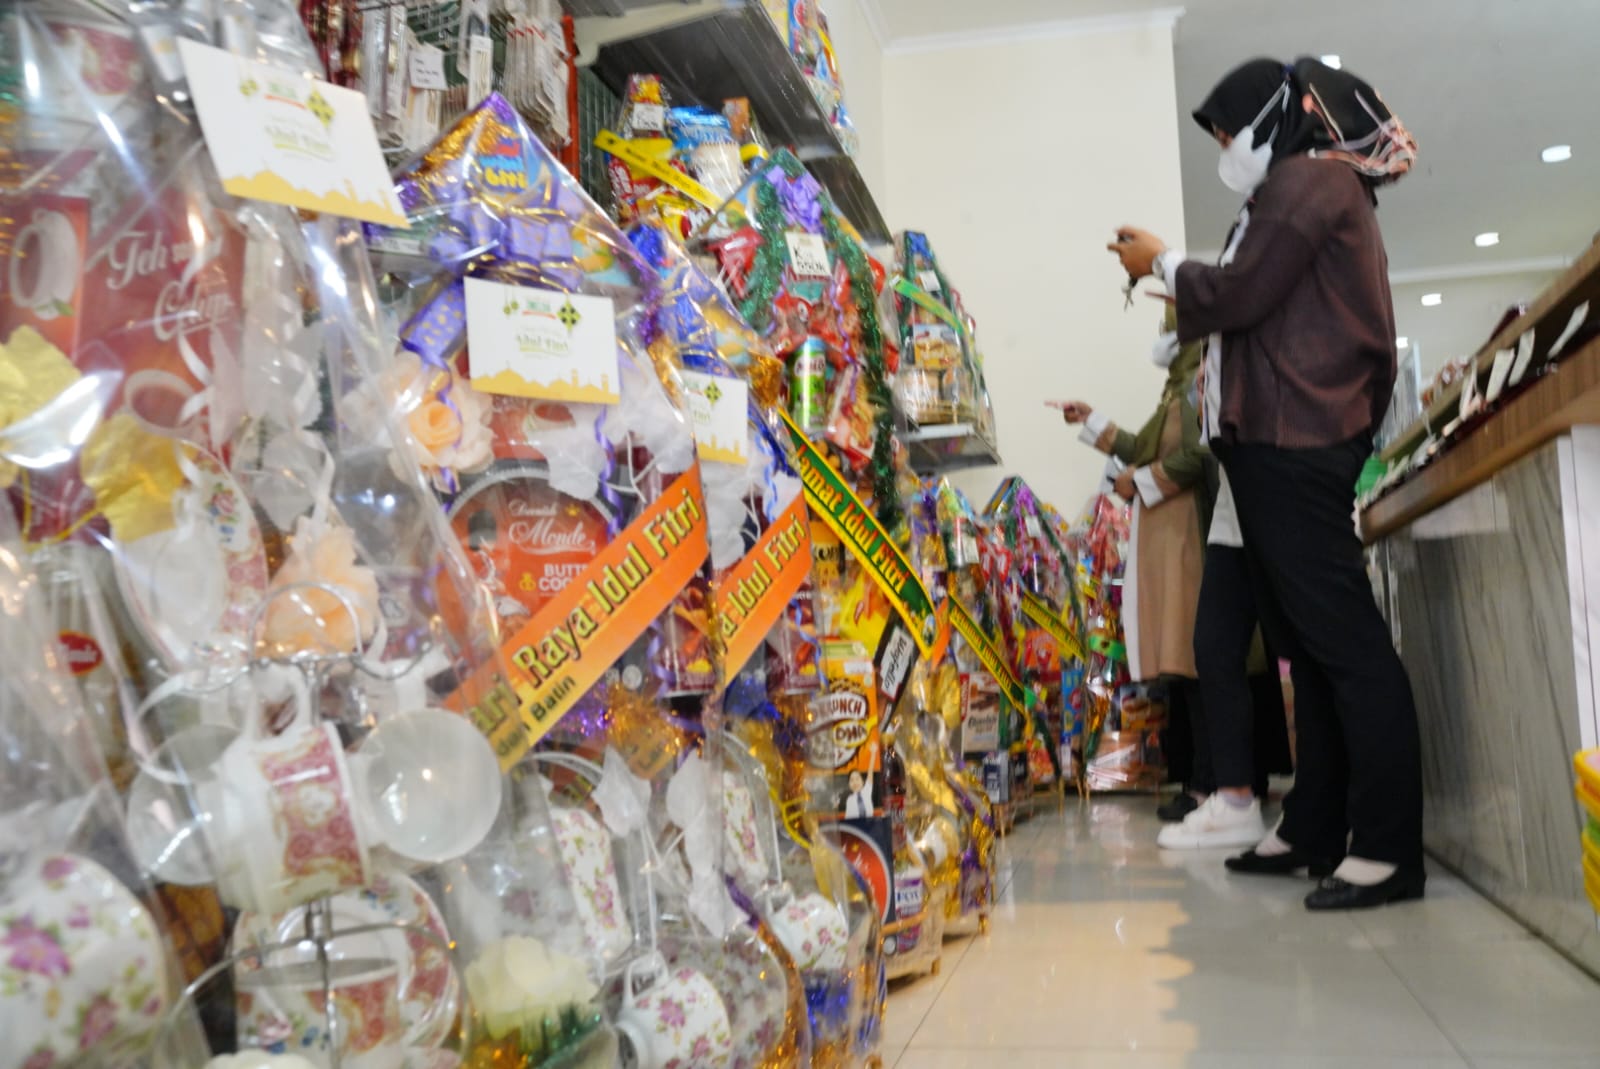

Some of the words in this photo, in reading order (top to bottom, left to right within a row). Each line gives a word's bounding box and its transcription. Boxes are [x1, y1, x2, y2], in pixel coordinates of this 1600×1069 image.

[509, 518, 588, 547] Monde
[728, 559, 773, 617] Idul
[764, 513, 806, 571] Fitri
[837, 501, 879, 553] Idul
[870, 542, 910, 594] Fitri
[544, 563, 588, 577] BUTT
[468, 673, 522, 733] ari
[511, 606, 599, 689] Raya
[587, 541, 652, 614] Idul
[642, 487, 700, 559] Fitri
[530, 675, 576, 722] Batin
